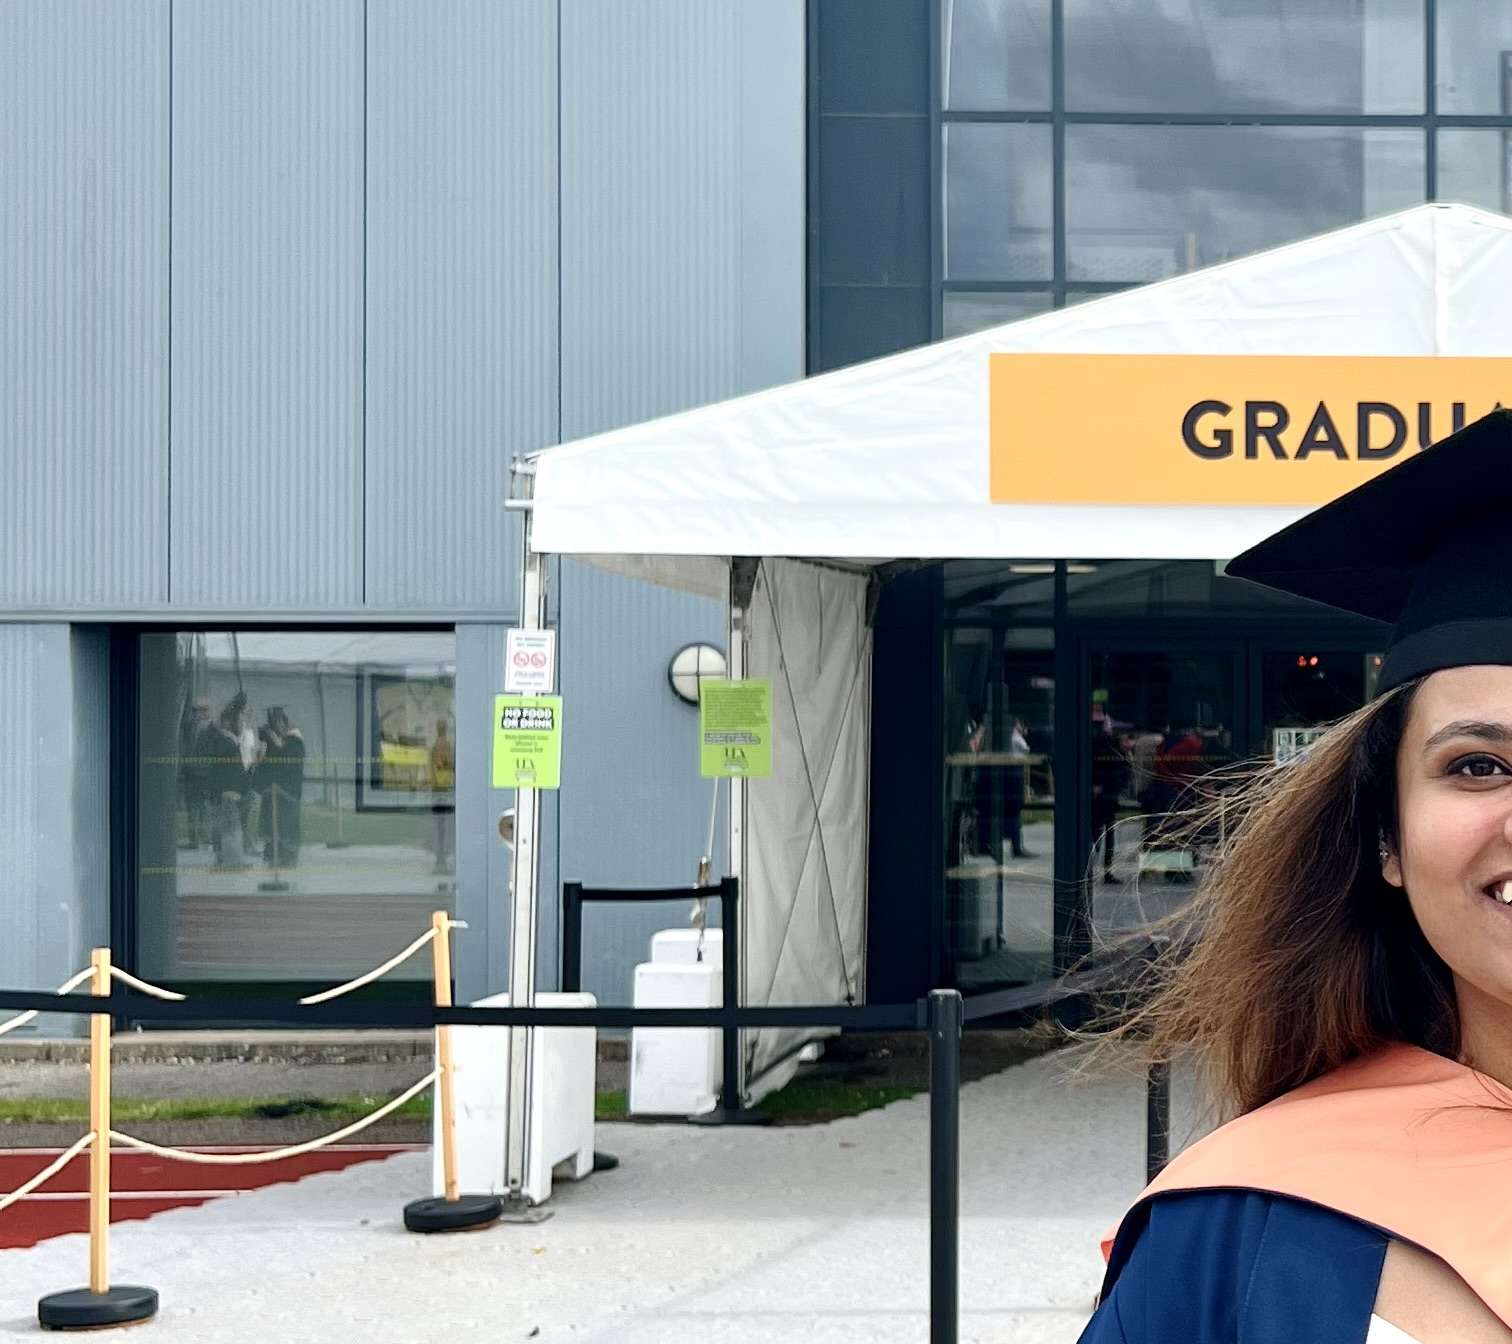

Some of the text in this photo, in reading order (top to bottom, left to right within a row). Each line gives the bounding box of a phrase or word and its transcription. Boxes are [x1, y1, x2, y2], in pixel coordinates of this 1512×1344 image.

[504, 707, 552, 719] NO FOOD
[519, 717, 552, 729] DRINK
